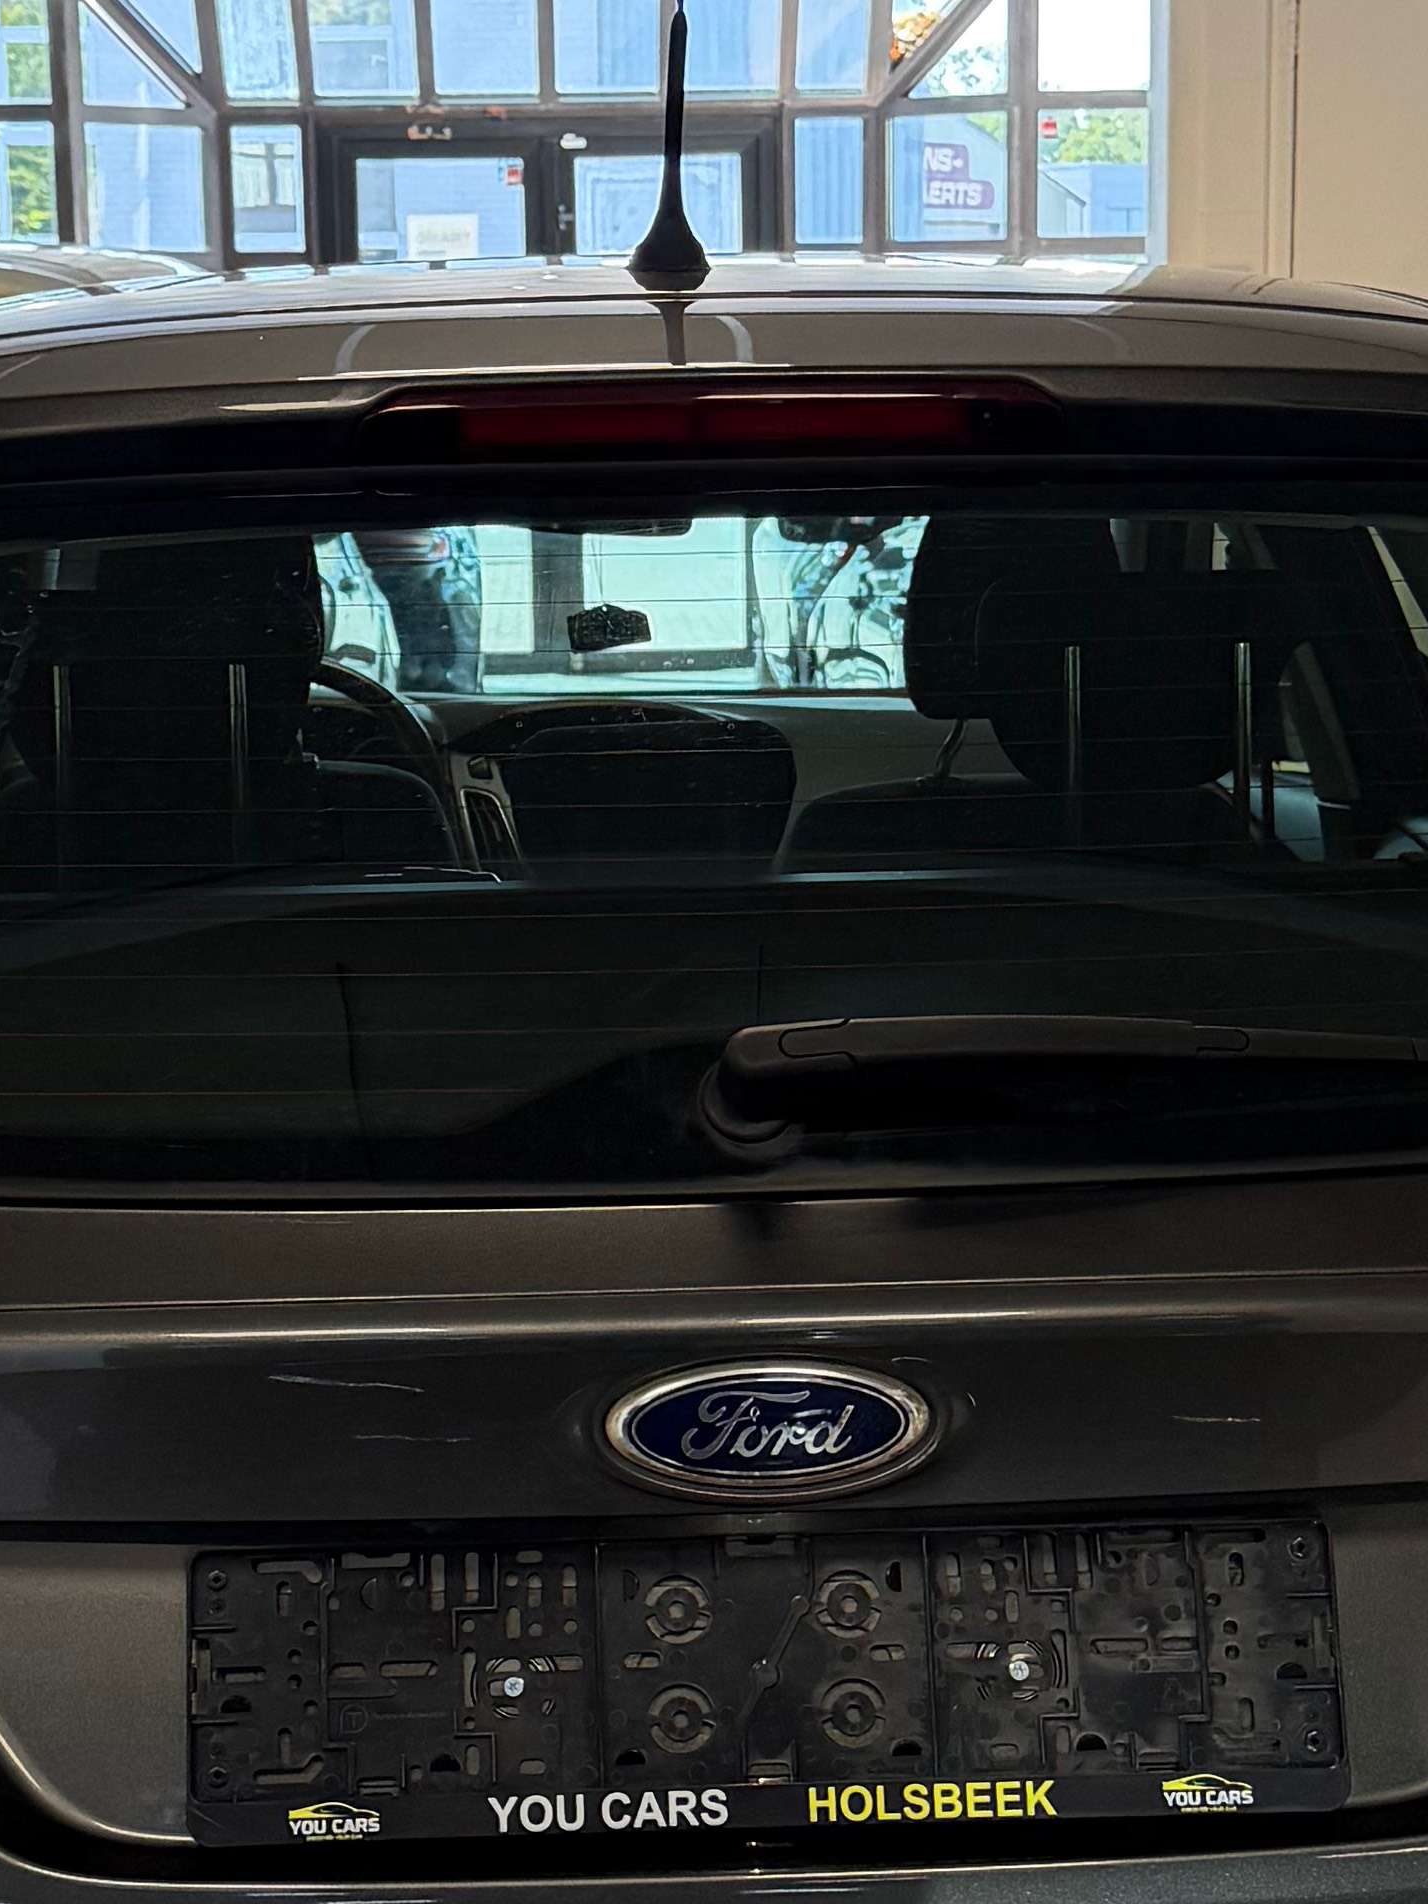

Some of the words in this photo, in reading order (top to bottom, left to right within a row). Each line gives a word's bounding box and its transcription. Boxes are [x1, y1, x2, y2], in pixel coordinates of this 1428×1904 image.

[681, 1390, 855, 1460] Ford
[488, 1793, 585, 1833] YOU
[601, 1788, 729, 1829] CARS
[808, 1780, 1059, 1823] HOLSBEEK
[1163, 1791, 1201, 1807] YOU
[1206, 1790, 1254, 1805] CARS
[289, 1819, 326, 1836] YOU
[332, 1817, 381, 1833] CARS
